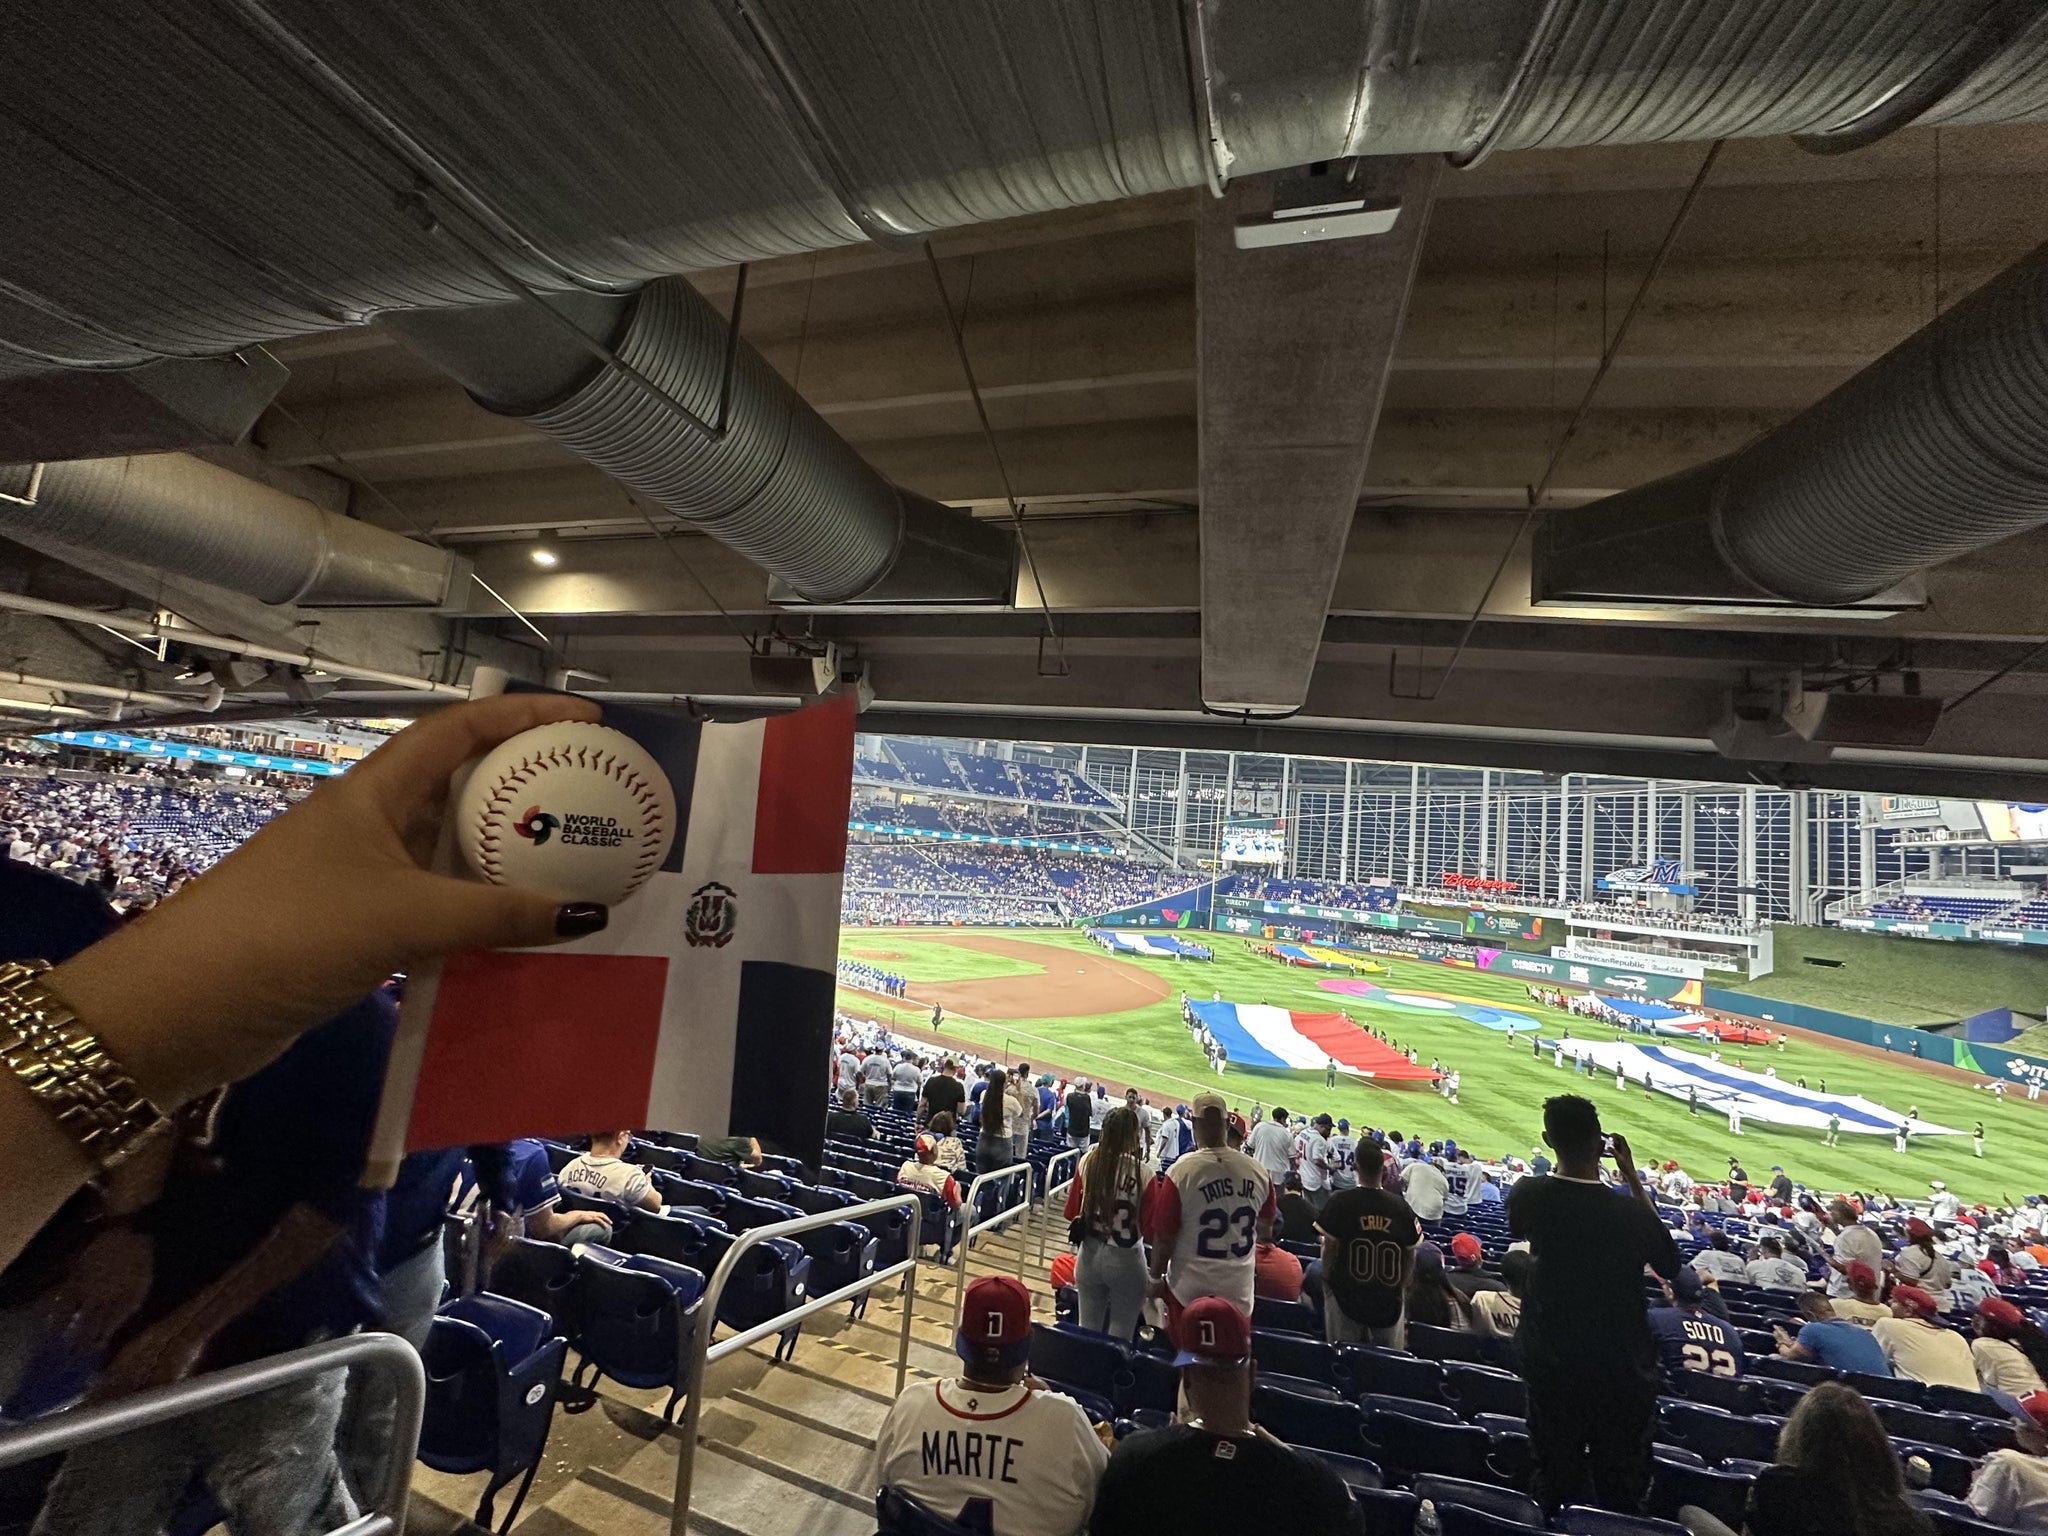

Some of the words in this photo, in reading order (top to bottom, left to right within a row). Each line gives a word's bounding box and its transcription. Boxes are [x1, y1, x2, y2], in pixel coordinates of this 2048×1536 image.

[562, 824, 634, 838] BASEBALL
[564, 814, 616, 827] WORLD
[561, 834, 622, 847] CLASSIC
[1442, 872, 1519, 890] Budweiser
[1225, 898, 1250, 907] DIRECTV
[1511, 958, 1555, 974] DIRECTV
[568, 1168, 608, 1189] ACEVEDO
[1199, 1178, 1234, 1203] TATIS
[1237, 1178, 1256, 1200] JR.
[1197, 1206, 1257, 1259] 23
[1360, 1215, 1392, 1233] CRUZ
[1349, 1238, 1401, 1286] 00
[987, 1311, 1003, 1337] D
[1200, 1320, 1216, 1346] D
[1682, 1321, 1725, 1344] SOTO
[1682, 1344, 1737, 1376] 22
[922, 1430, 1024, 1484] MARTE
